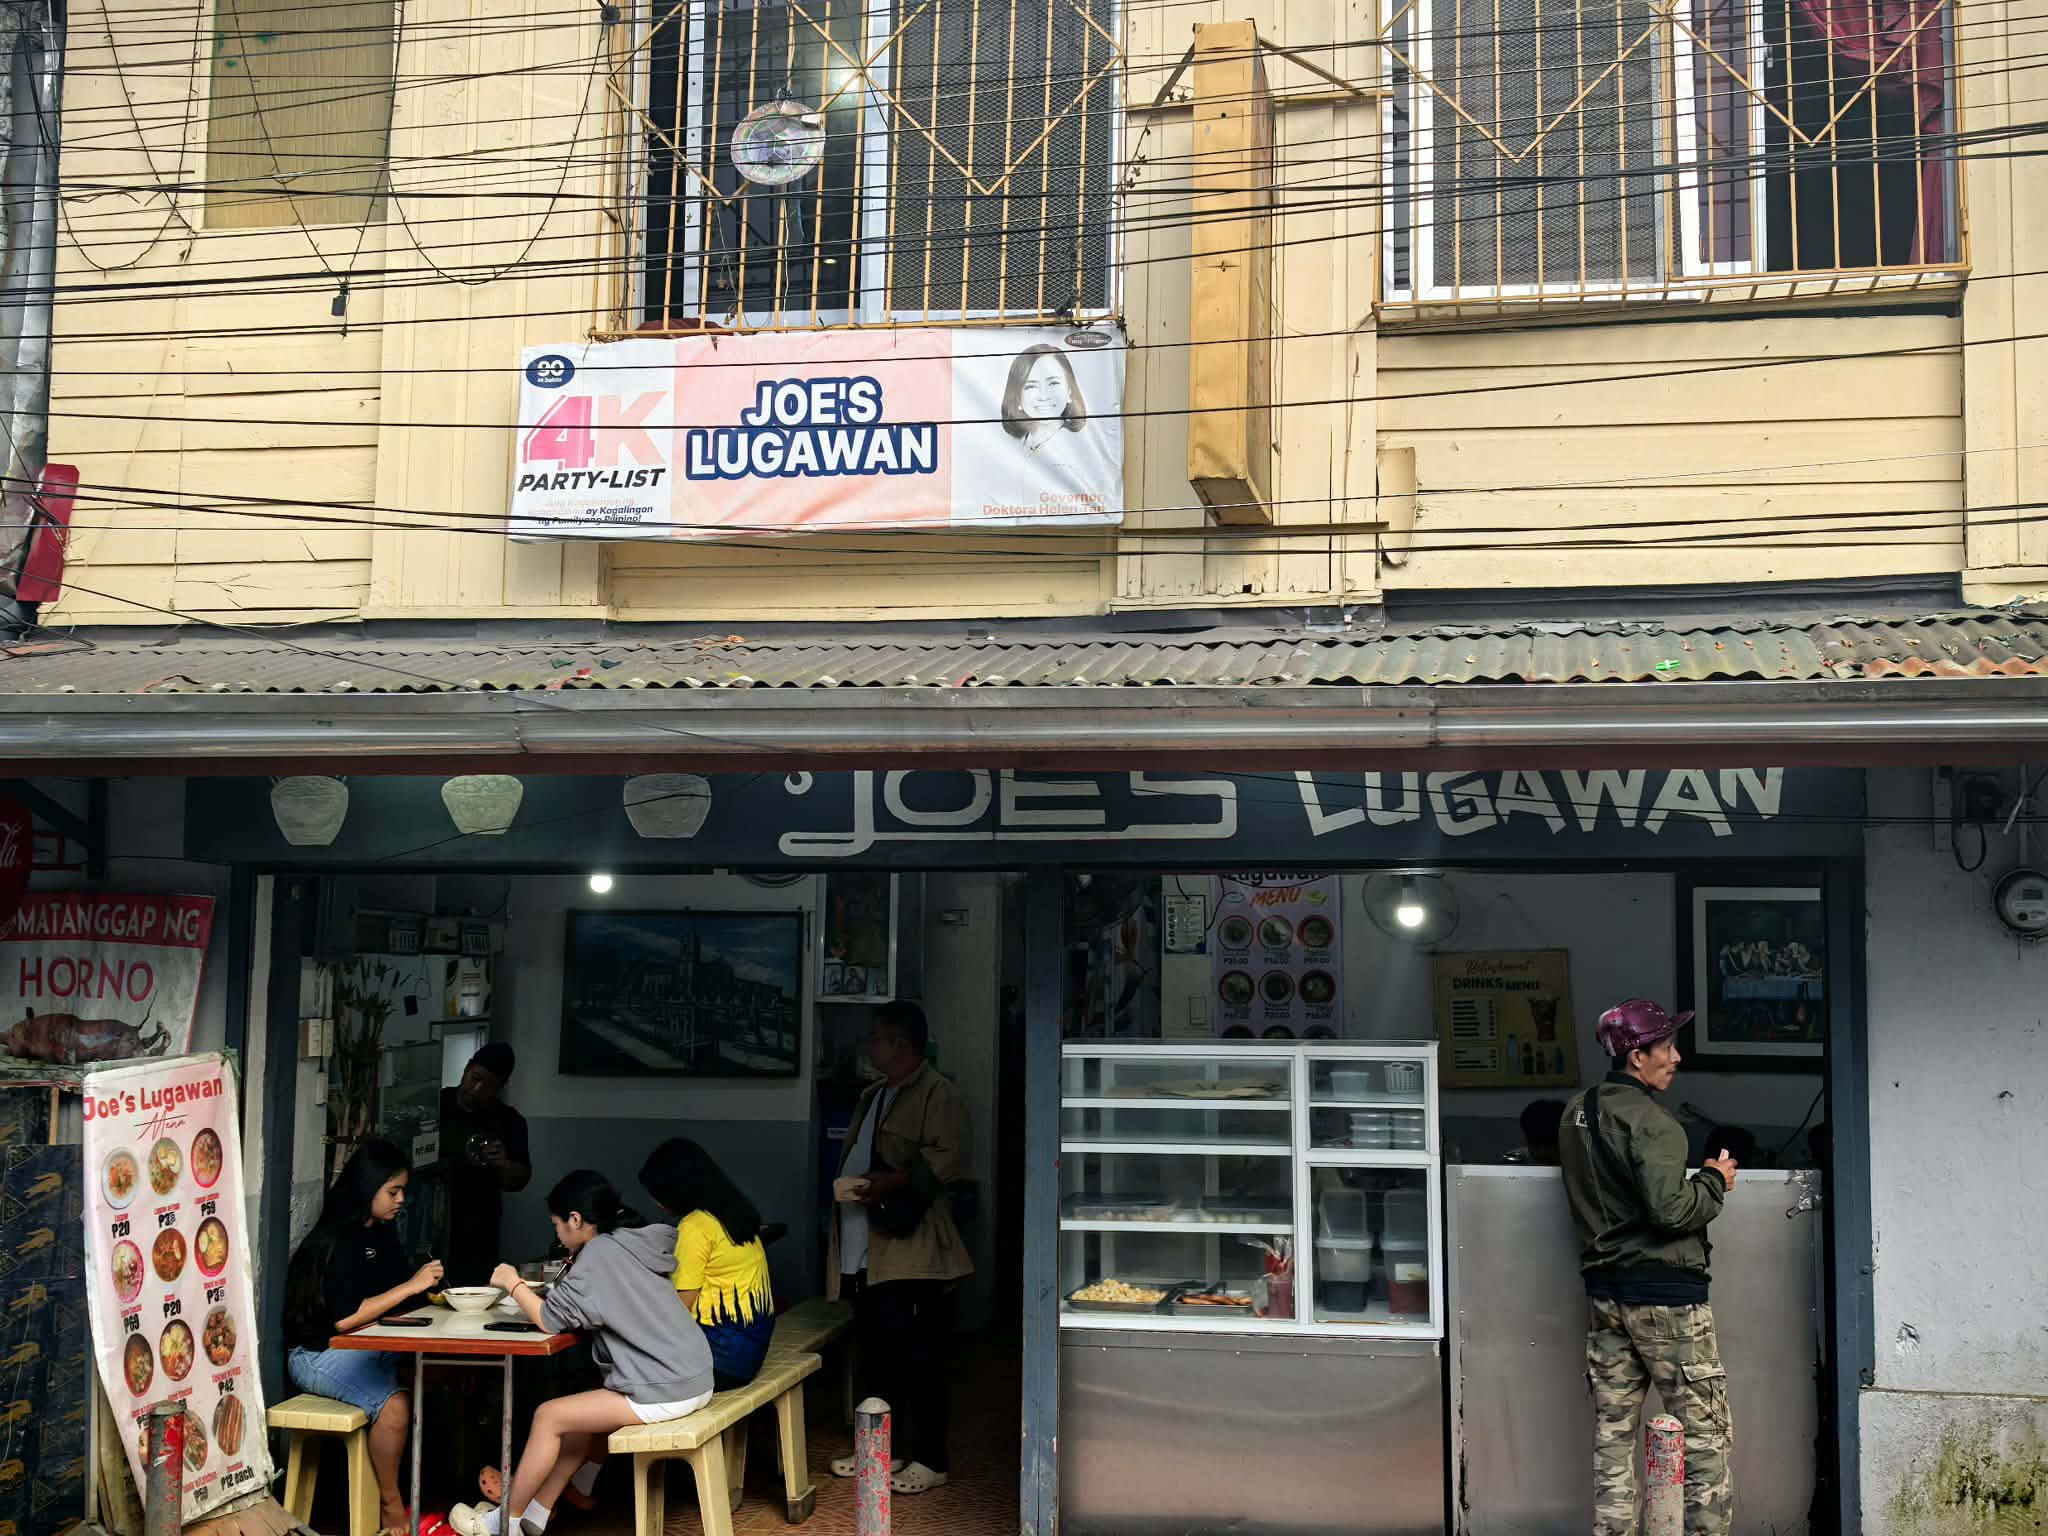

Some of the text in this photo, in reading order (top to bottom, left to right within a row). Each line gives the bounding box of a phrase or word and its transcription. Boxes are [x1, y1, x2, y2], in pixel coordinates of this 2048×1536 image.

[538, 360, 565, 376] 90
[743, 378, 881, 427] JOE'S
[522, 390, 668, 471] 4K
[689, 426, 935, 477] LUGAWAN
[517, 468, 666, 492] PARTY-LIST
[983, 504, 1038, 516] Doktora
[1040, 503, 1077, 514] Helen
[1040, 492, 1105, 503] Governor
[586, 508, 597, 516] ay
[600, 505, 653, 516] Kagalingan
[1294, 767, 1785, 837] LUGAWAN
[1250, 887, 1302, 905] MENU
[14, 903, 201, 941] MATANGGAP NG
[19, 956, 155, 1003] HORNO
[1452, 976, 1504, 990] DRINKS
[82, 1077, 223, 1122] Joe's Lugawan
[234, 1465, 255, 1485] each
